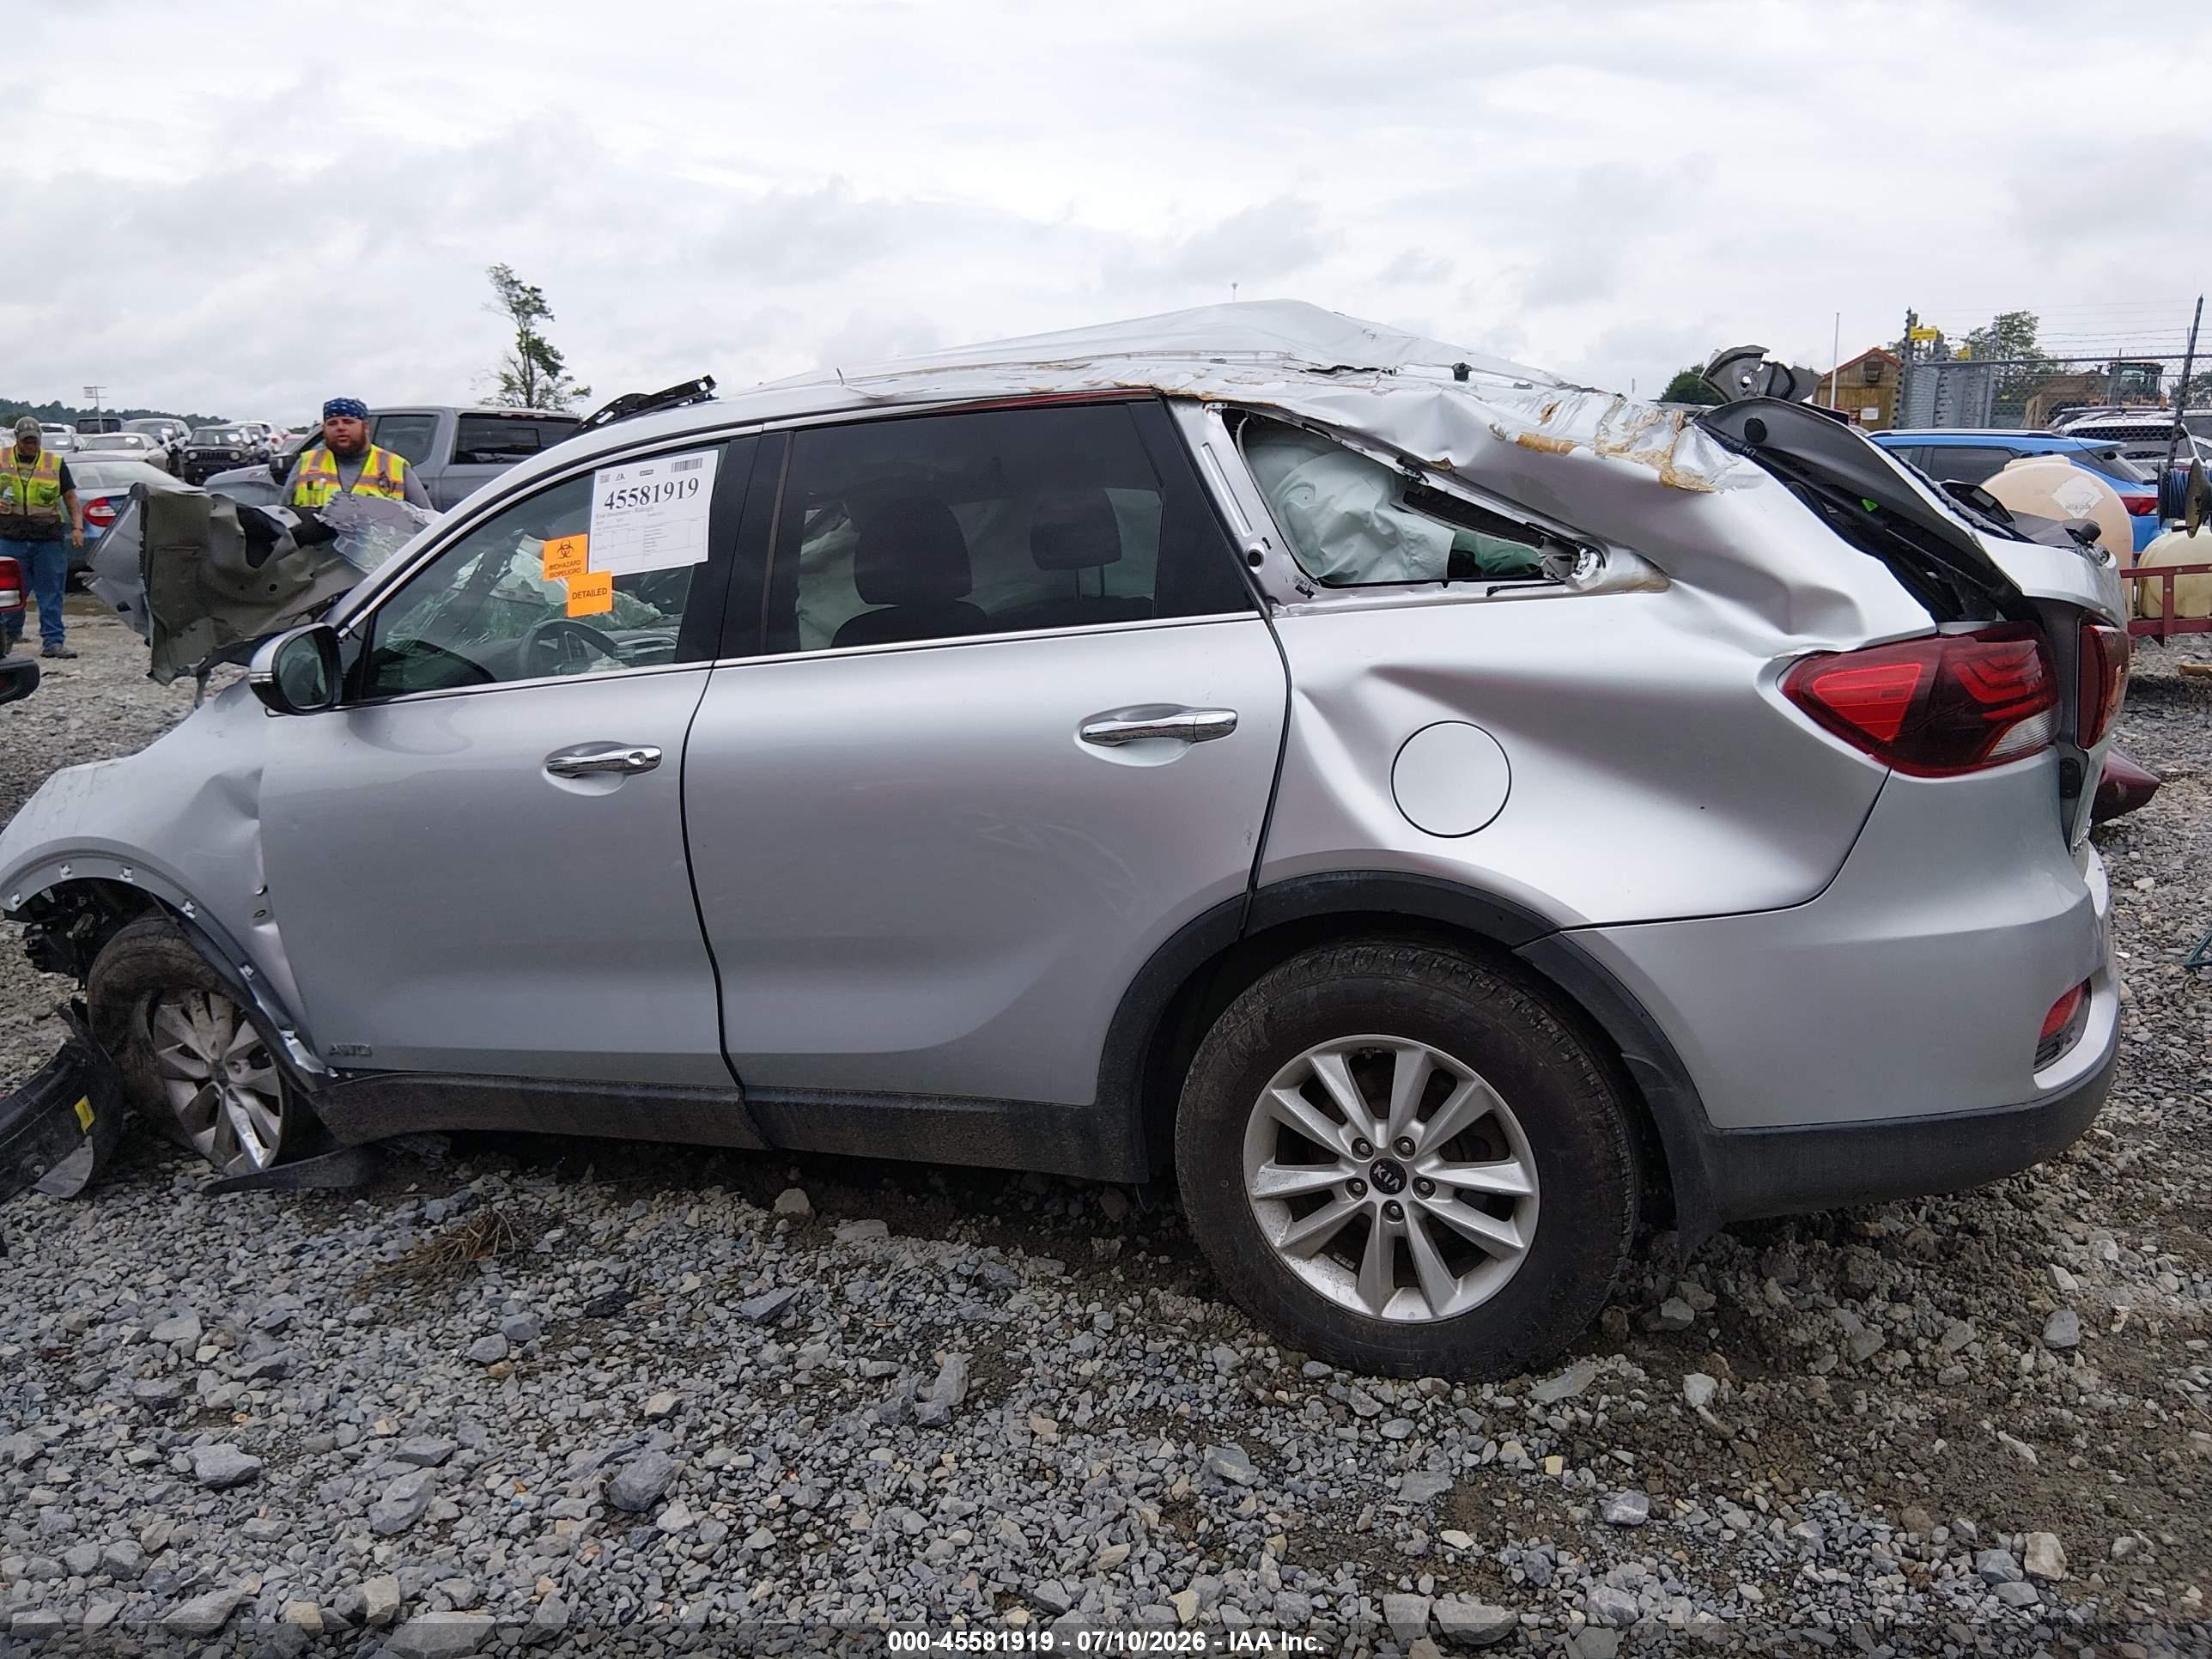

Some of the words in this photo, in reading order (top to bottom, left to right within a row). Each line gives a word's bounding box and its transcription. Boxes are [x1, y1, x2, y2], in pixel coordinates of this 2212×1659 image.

[604, 477, 700, 510] 45581919
[572, 587, 608, 599] DETAILED
[329, 1043, 373, 1057] AWD
[1374, 1164, 1400, 1190] KIA
